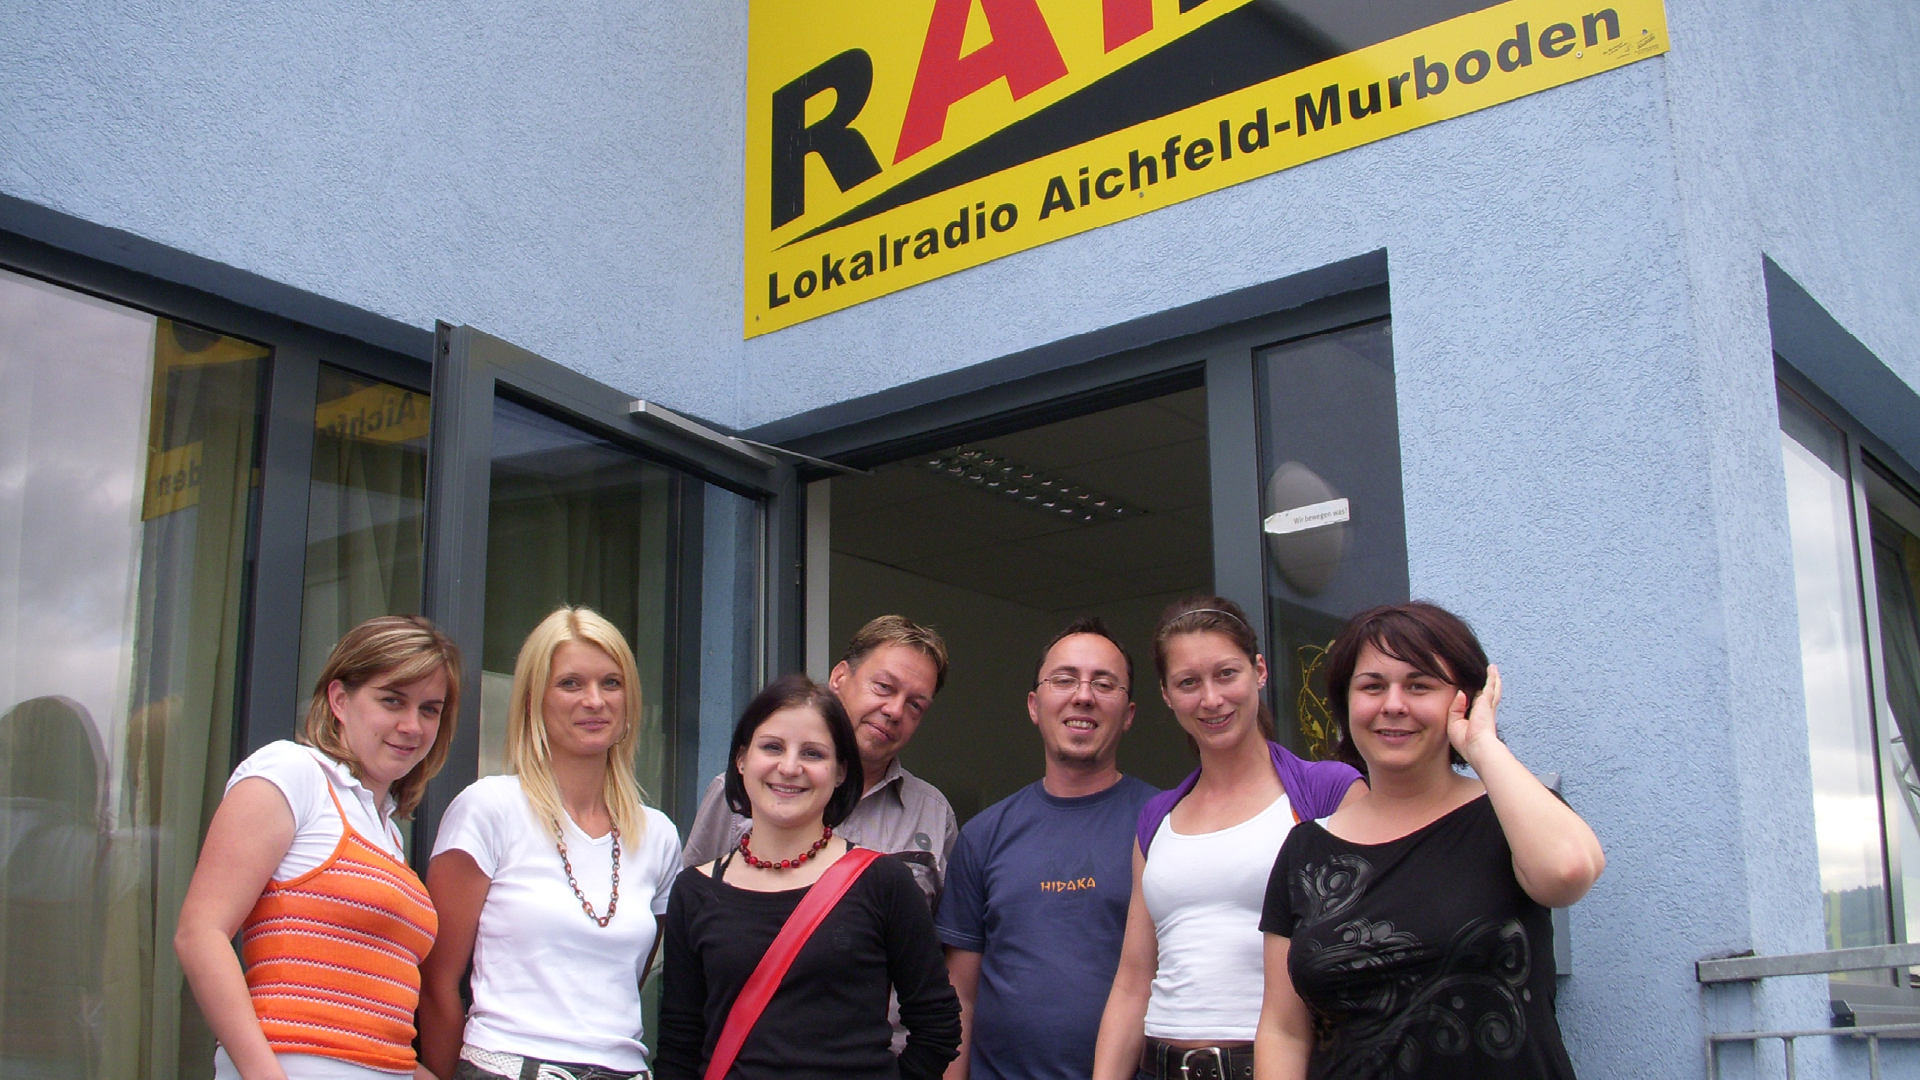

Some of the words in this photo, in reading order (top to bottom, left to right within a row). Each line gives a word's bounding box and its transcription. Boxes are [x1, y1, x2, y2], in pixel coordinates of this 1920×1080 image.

[769, 201, 1018, 309] Lokalradio
[1039, 8, 1621, 220] Aichfeld-Murboden
[1294, 516, 1304, 525] Wir
[1305, 511, 1331, 522] bewegen
[1041, 877, 1096, 893] HIDAKA
